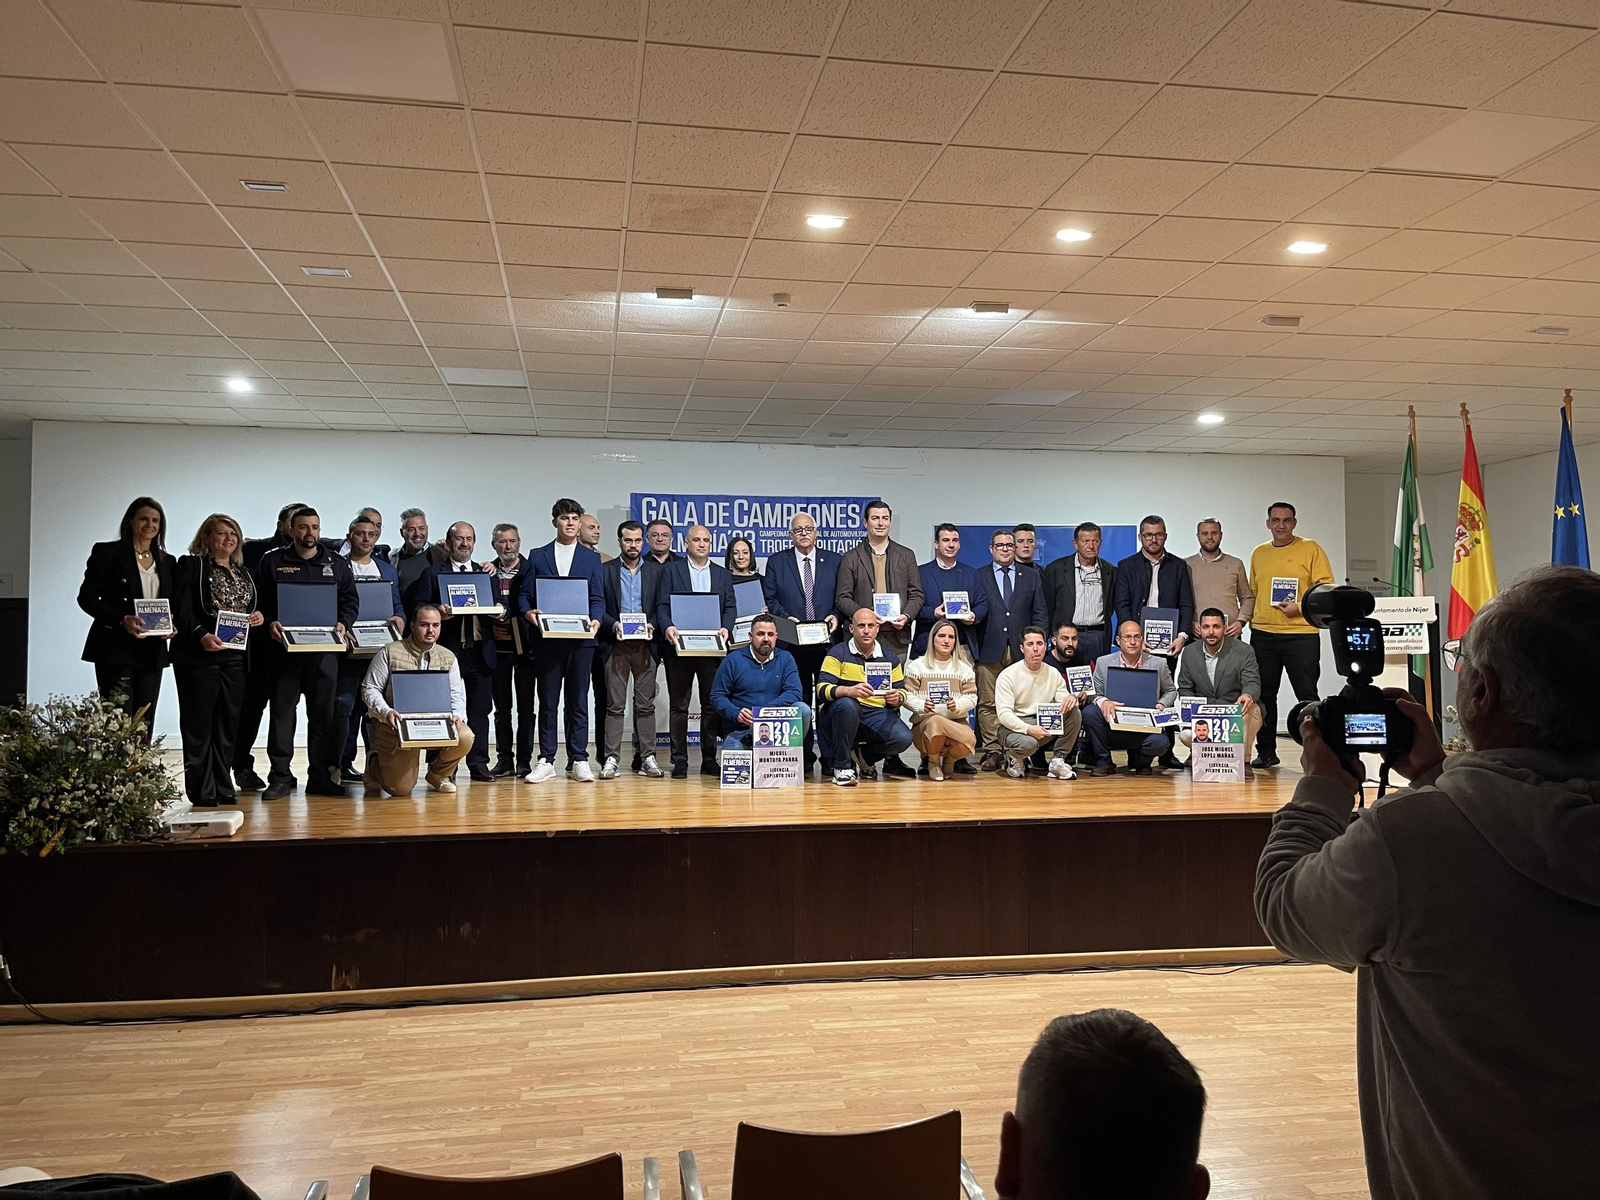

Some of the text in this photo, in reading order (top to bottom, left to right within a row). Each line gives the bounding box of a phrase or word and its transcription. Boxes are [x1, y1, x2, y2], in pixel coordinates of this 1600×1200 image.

[642, 497, 699, 527] GALA
[705, 501, 730, 527] DE
[760, 539, 795, 554] TROFE
[1352, 634, 1370, 645] 5.7
[774, 722, 790, 734] 20
[1213, 719, 1230, 731] 20
[774, 734, 790, 747] 24
[1213, 731, 1230, 743] 24
